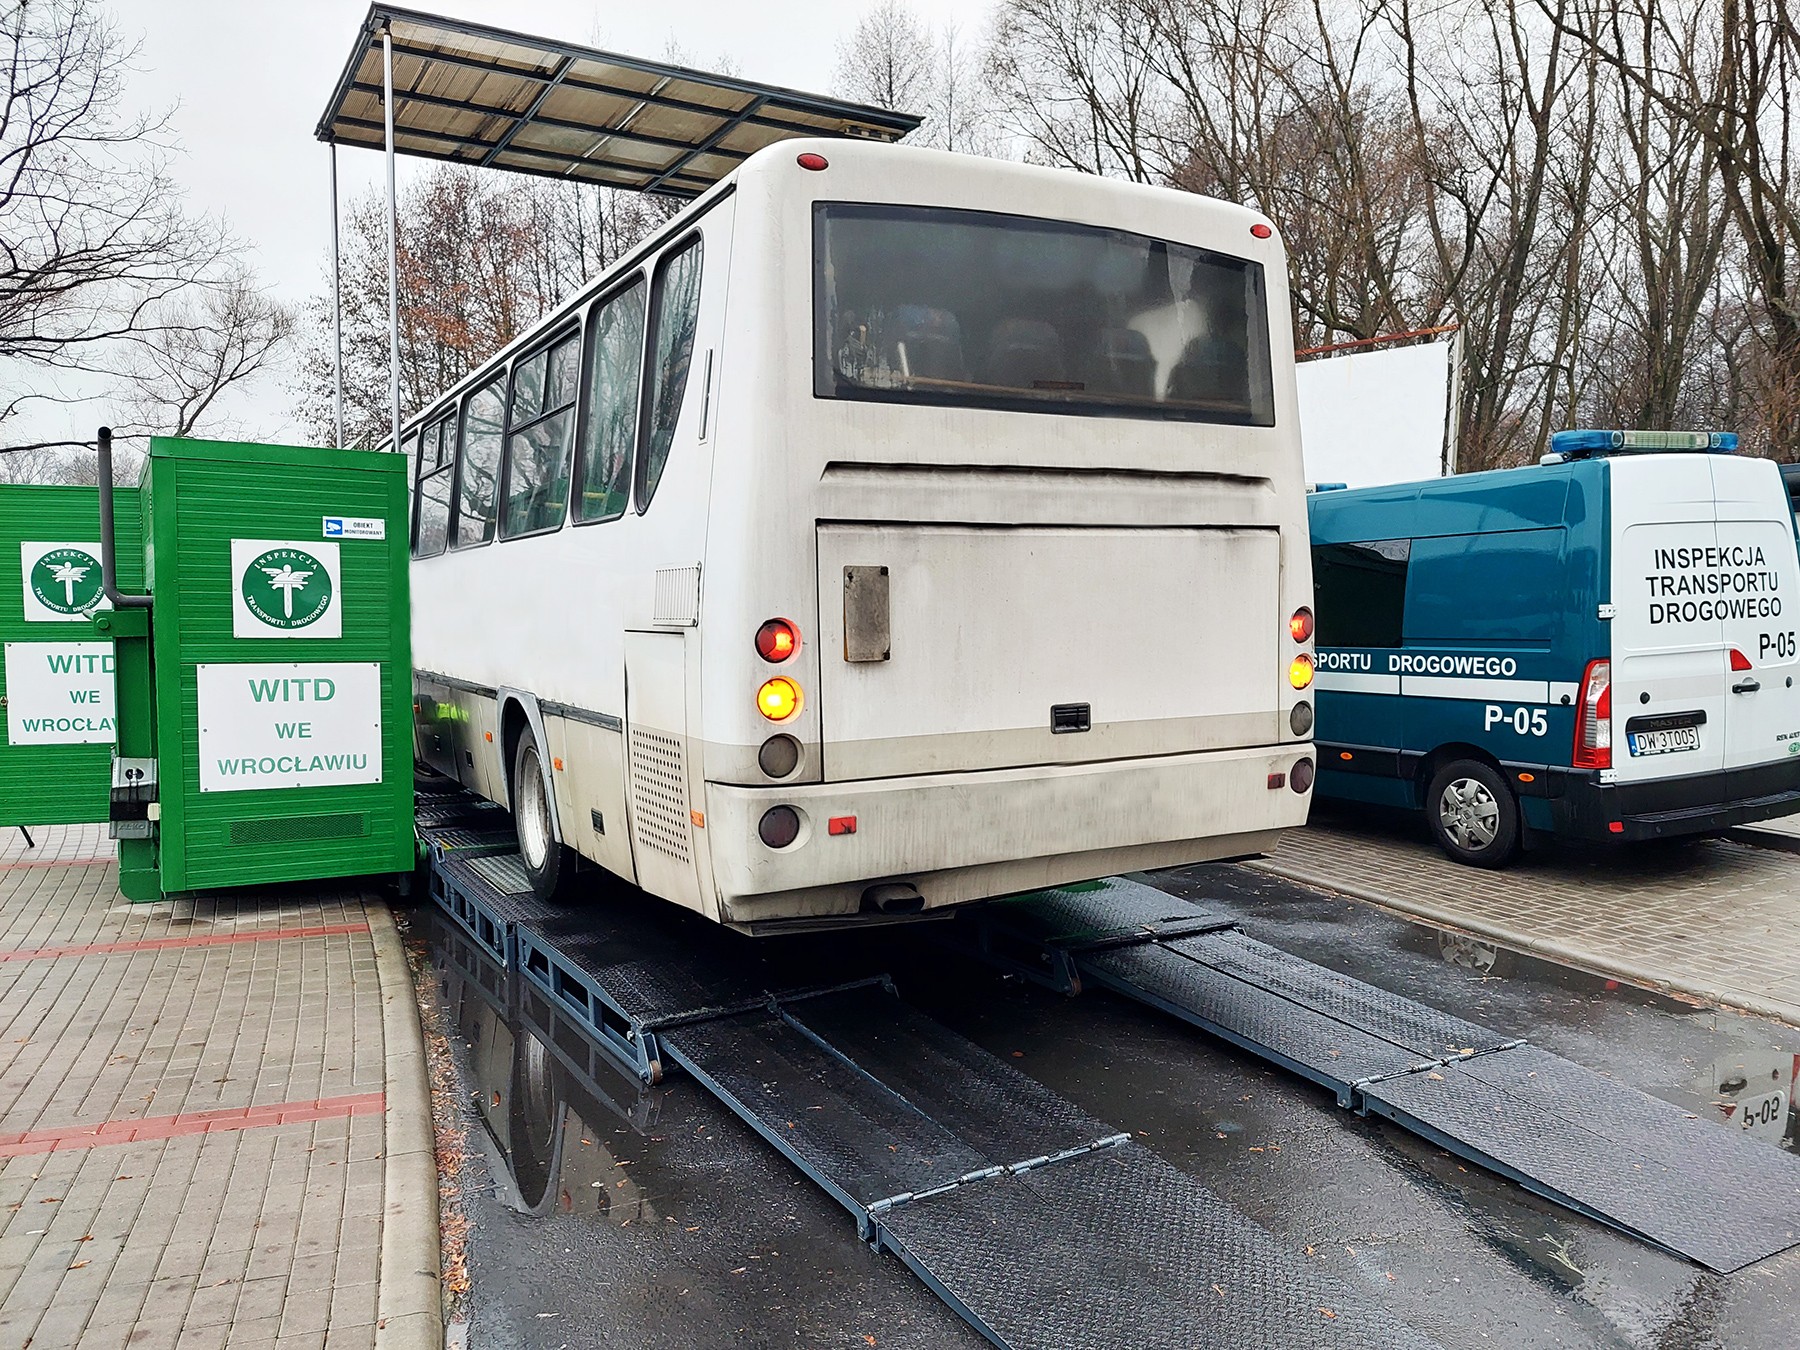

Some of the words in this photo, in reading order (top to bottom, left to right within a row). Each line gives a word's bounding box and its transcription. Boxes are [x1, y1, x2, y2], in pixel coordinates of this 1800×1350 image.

[352, 521, 373, 529] OBIEKT
[40, 551, 94, 567] INSPEKCJA
[254, 551, 318, 570] INSPEKCJA
[1654, 546, 1766, 570] INSPEKCJA
[1645, 572, 1779, 597] TRANSPORTU
[35, 586, 69, 612] TRANSPORTU
[247, 595, 286, 626] TRANSPORTU
[291, 595, 328, 627] DROGOWEGO
[1649, 597, 1782, 625] DROGOWEGO
[1759, 631, 1796, 660] P-05
[46, 654, 115, 674] WITD
[1388, 654, 1517, 677] DROGOWEGO
[69, 690, 101, 704] WE
[248, 678, 336, 703] WITD
[22, 717, 116, 732] WROCŁA
[274, 722, 312, 739] WE
[1484, 704, 1548, 737] P-05
[1650, 717, 1692, 728] MASTER
[1637, 732, 1657, 751] DW
[1659, 728, 1696, 748] 3T005
[217, 753, 367, 776] WROCŁAWIU
